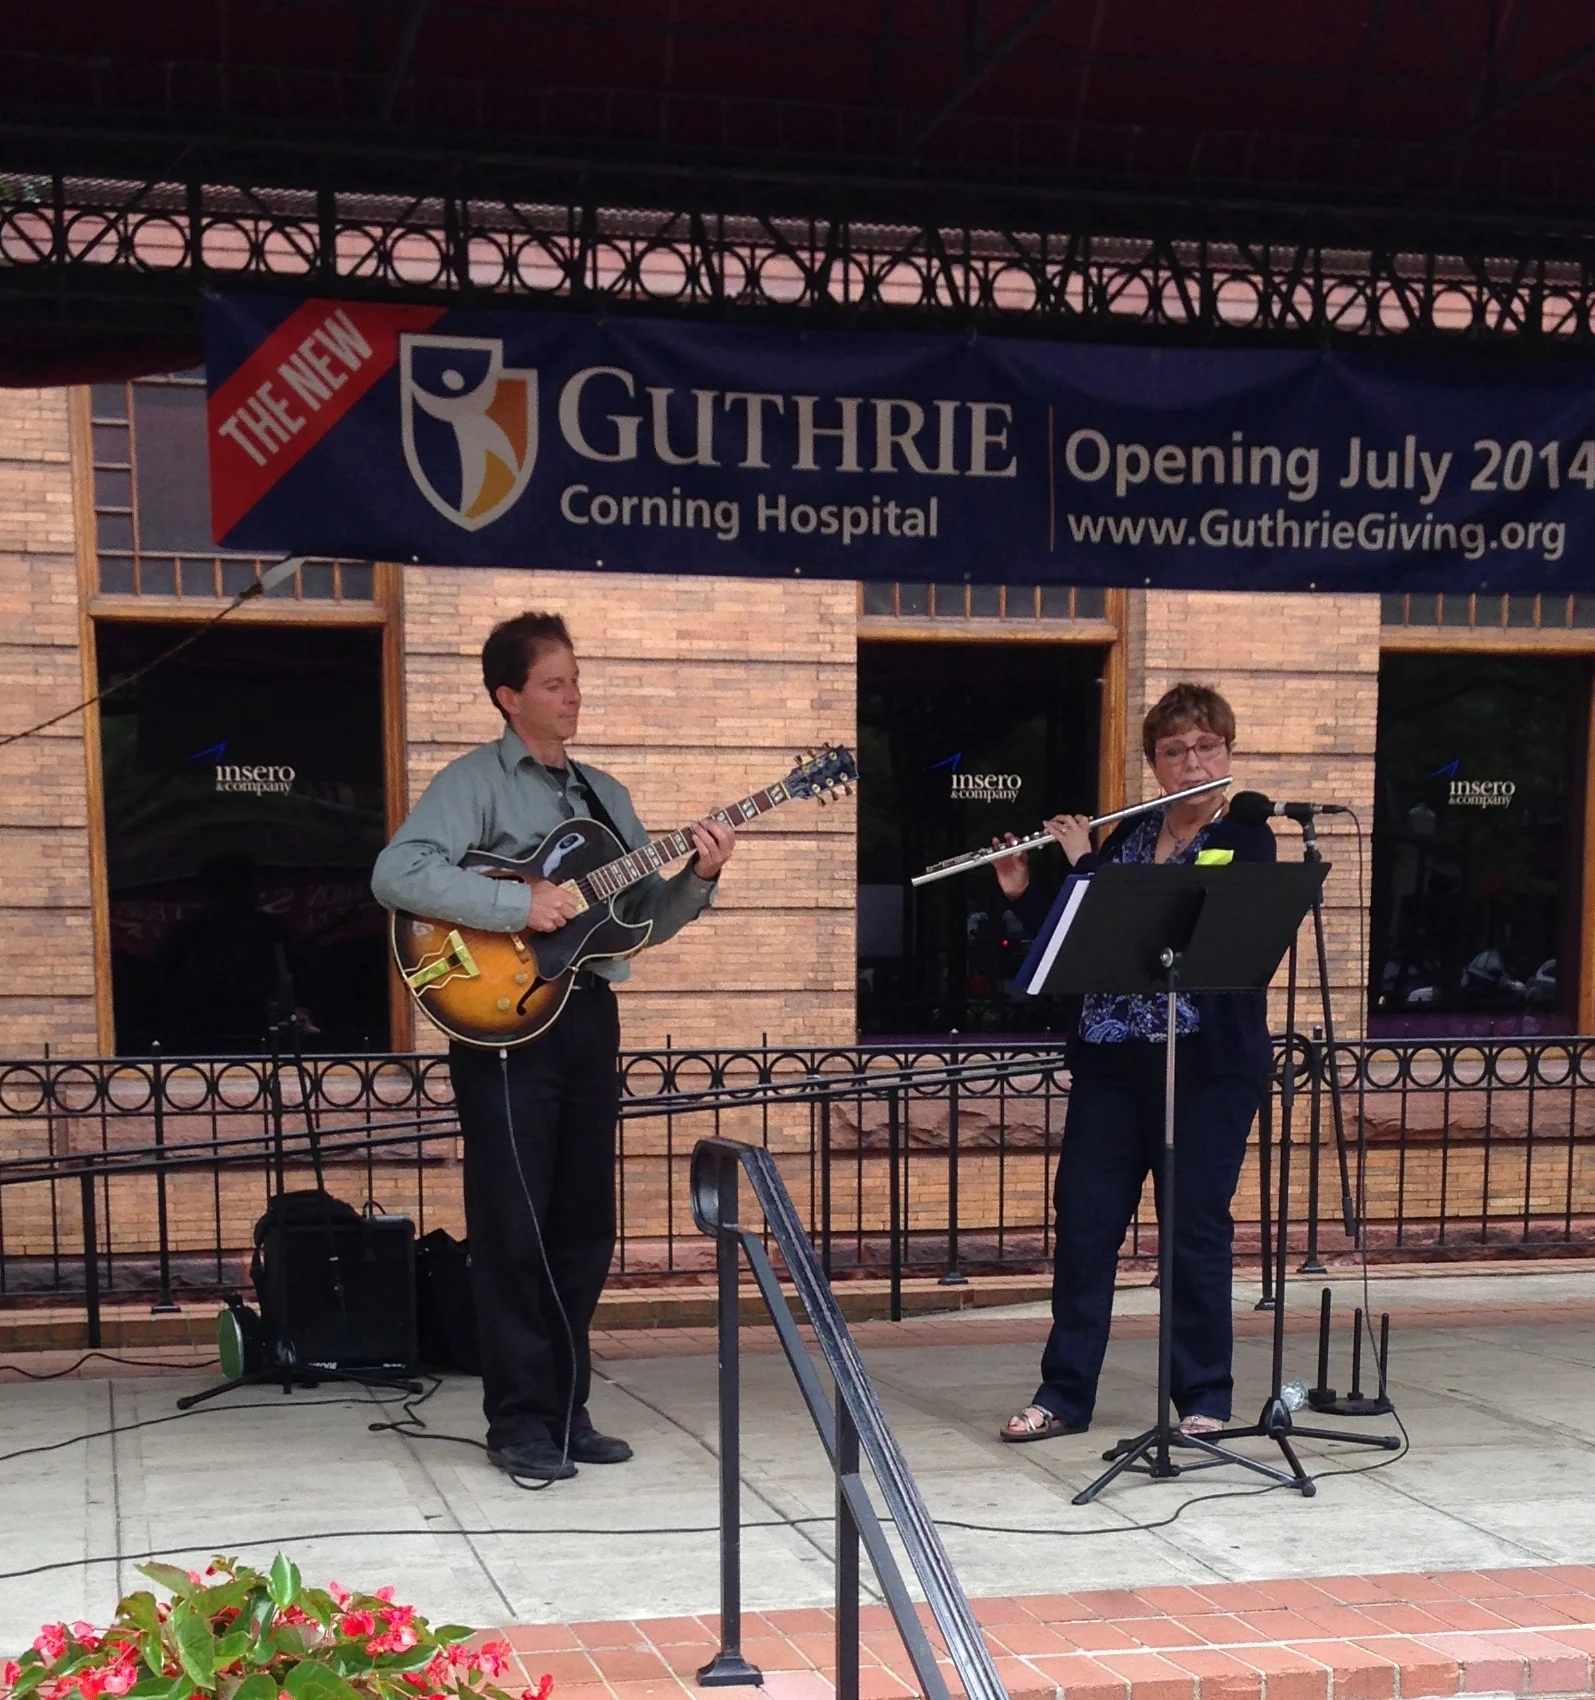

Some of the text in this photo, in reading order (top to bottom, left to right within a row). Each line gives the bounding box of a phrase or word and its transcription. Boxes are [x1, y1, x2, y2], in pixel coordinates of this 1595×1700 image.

[218, 308, 373, 467] THE NEW
[557, 366, 1018, 478] GUTHRIE
[1065, 428, 1595, 505] Opening July 2014
[560, 484, 938, 545] Corning Hospital
[1067, 509, 1566, 561] www.GuthrieGiving.org
[216, 765, 296, 781] insero
[951, 774, 1022, 789] insero
[1449, 781, 1516, 795] insero
